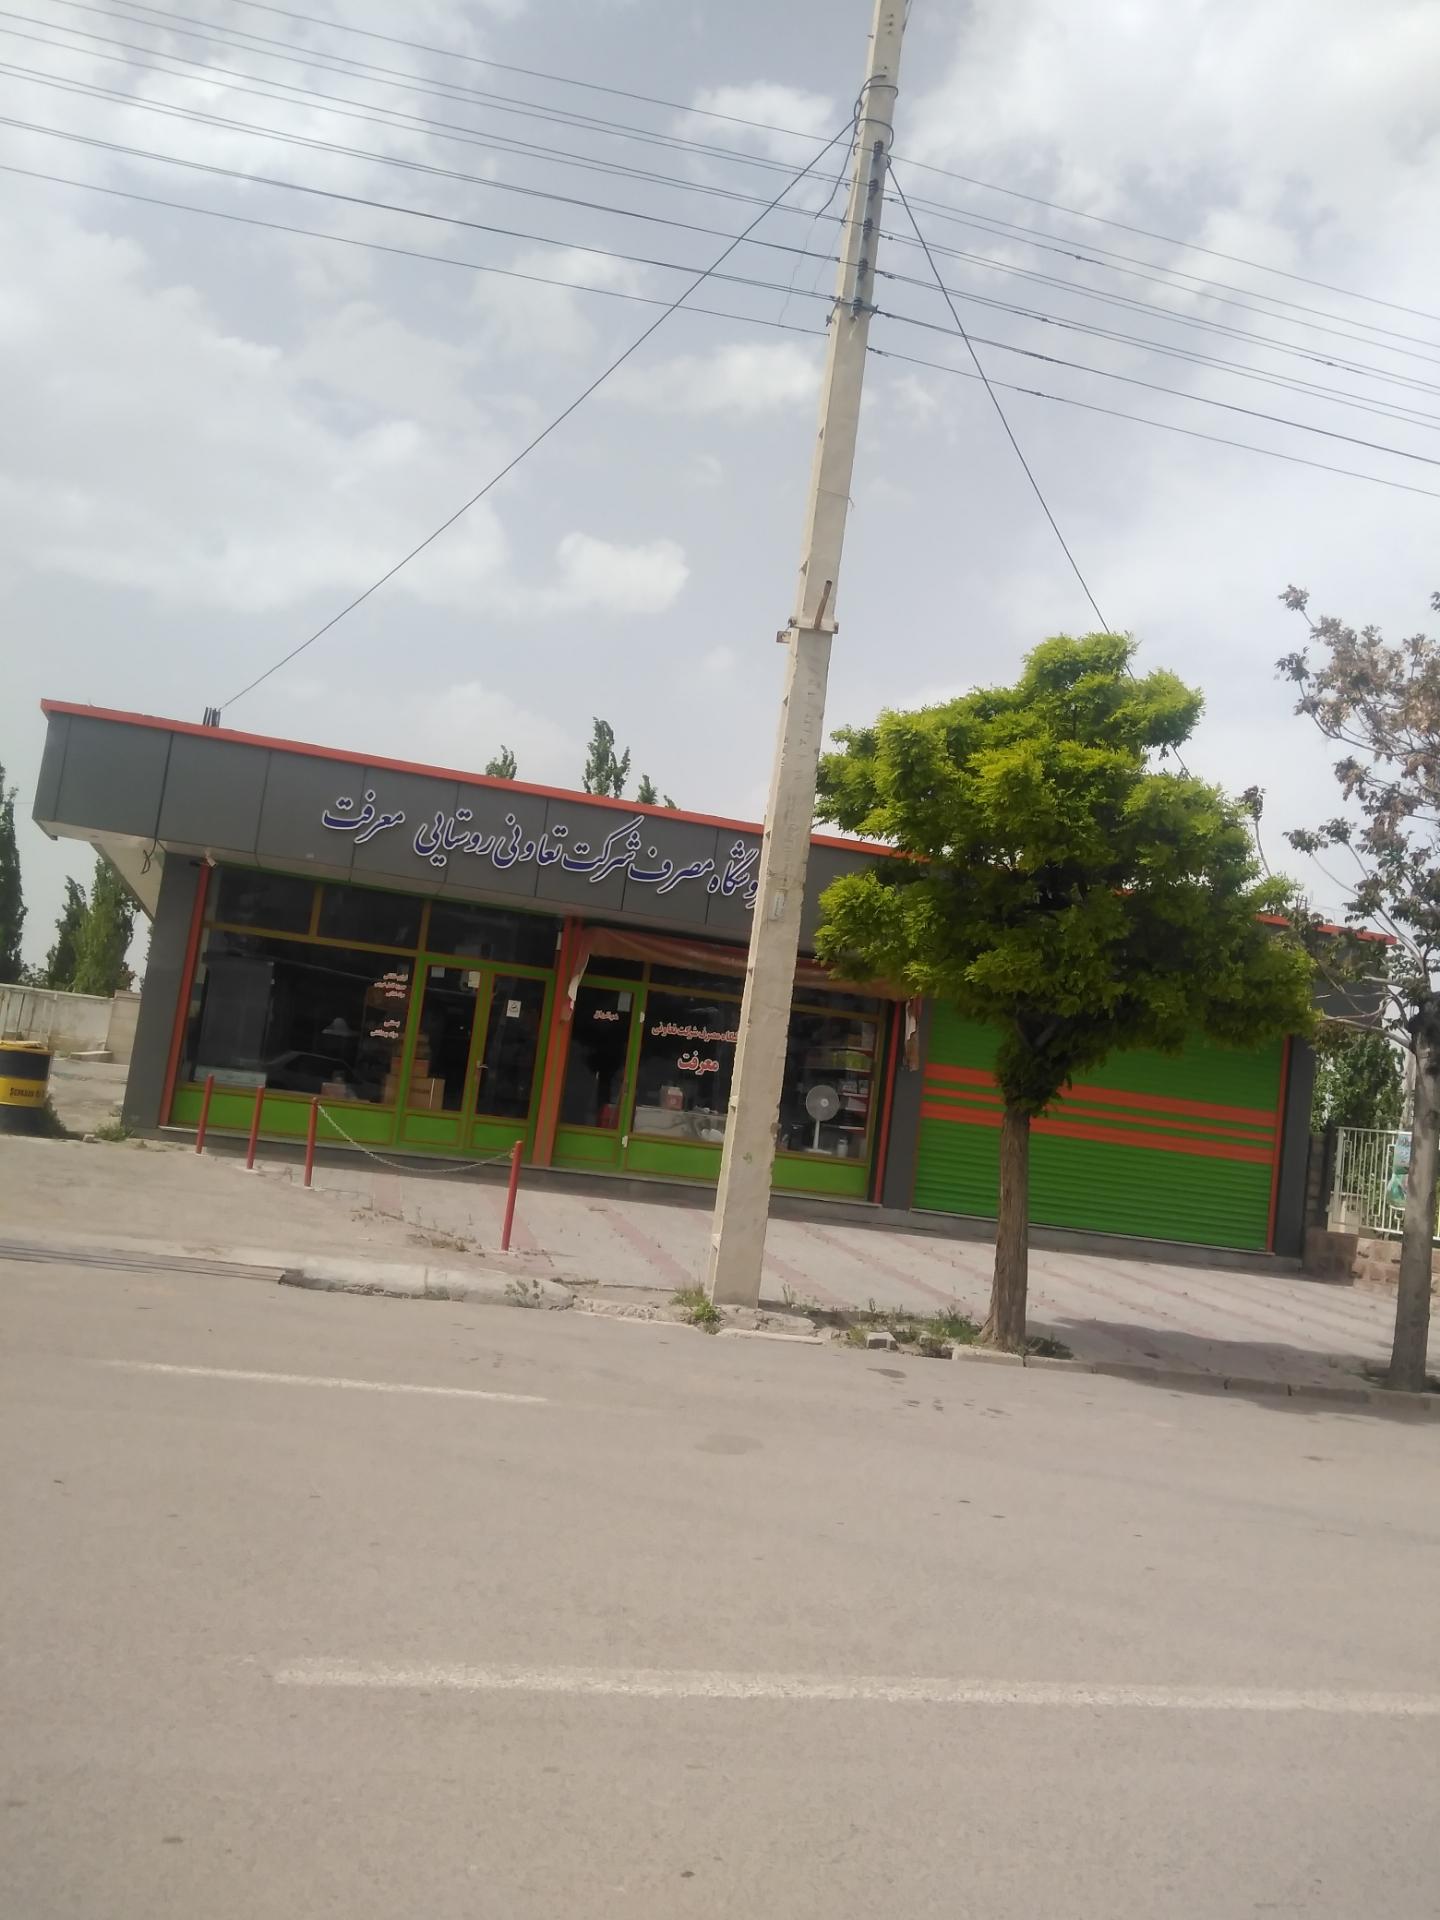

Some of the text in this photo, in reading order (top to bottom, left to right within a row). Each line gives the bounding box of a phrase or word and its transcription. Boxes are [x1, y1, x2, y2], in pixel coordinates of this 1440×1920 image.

[322, 790, 406, 844] معرفت
[413, 808, 495, 867] روستایی
[492, 813, 569, 868] تعاونی
[561, 815, 645, 882] شرکت
[628, 847, 714, 894] مصرف
[677, 1050, 719, 1075] معرفت
